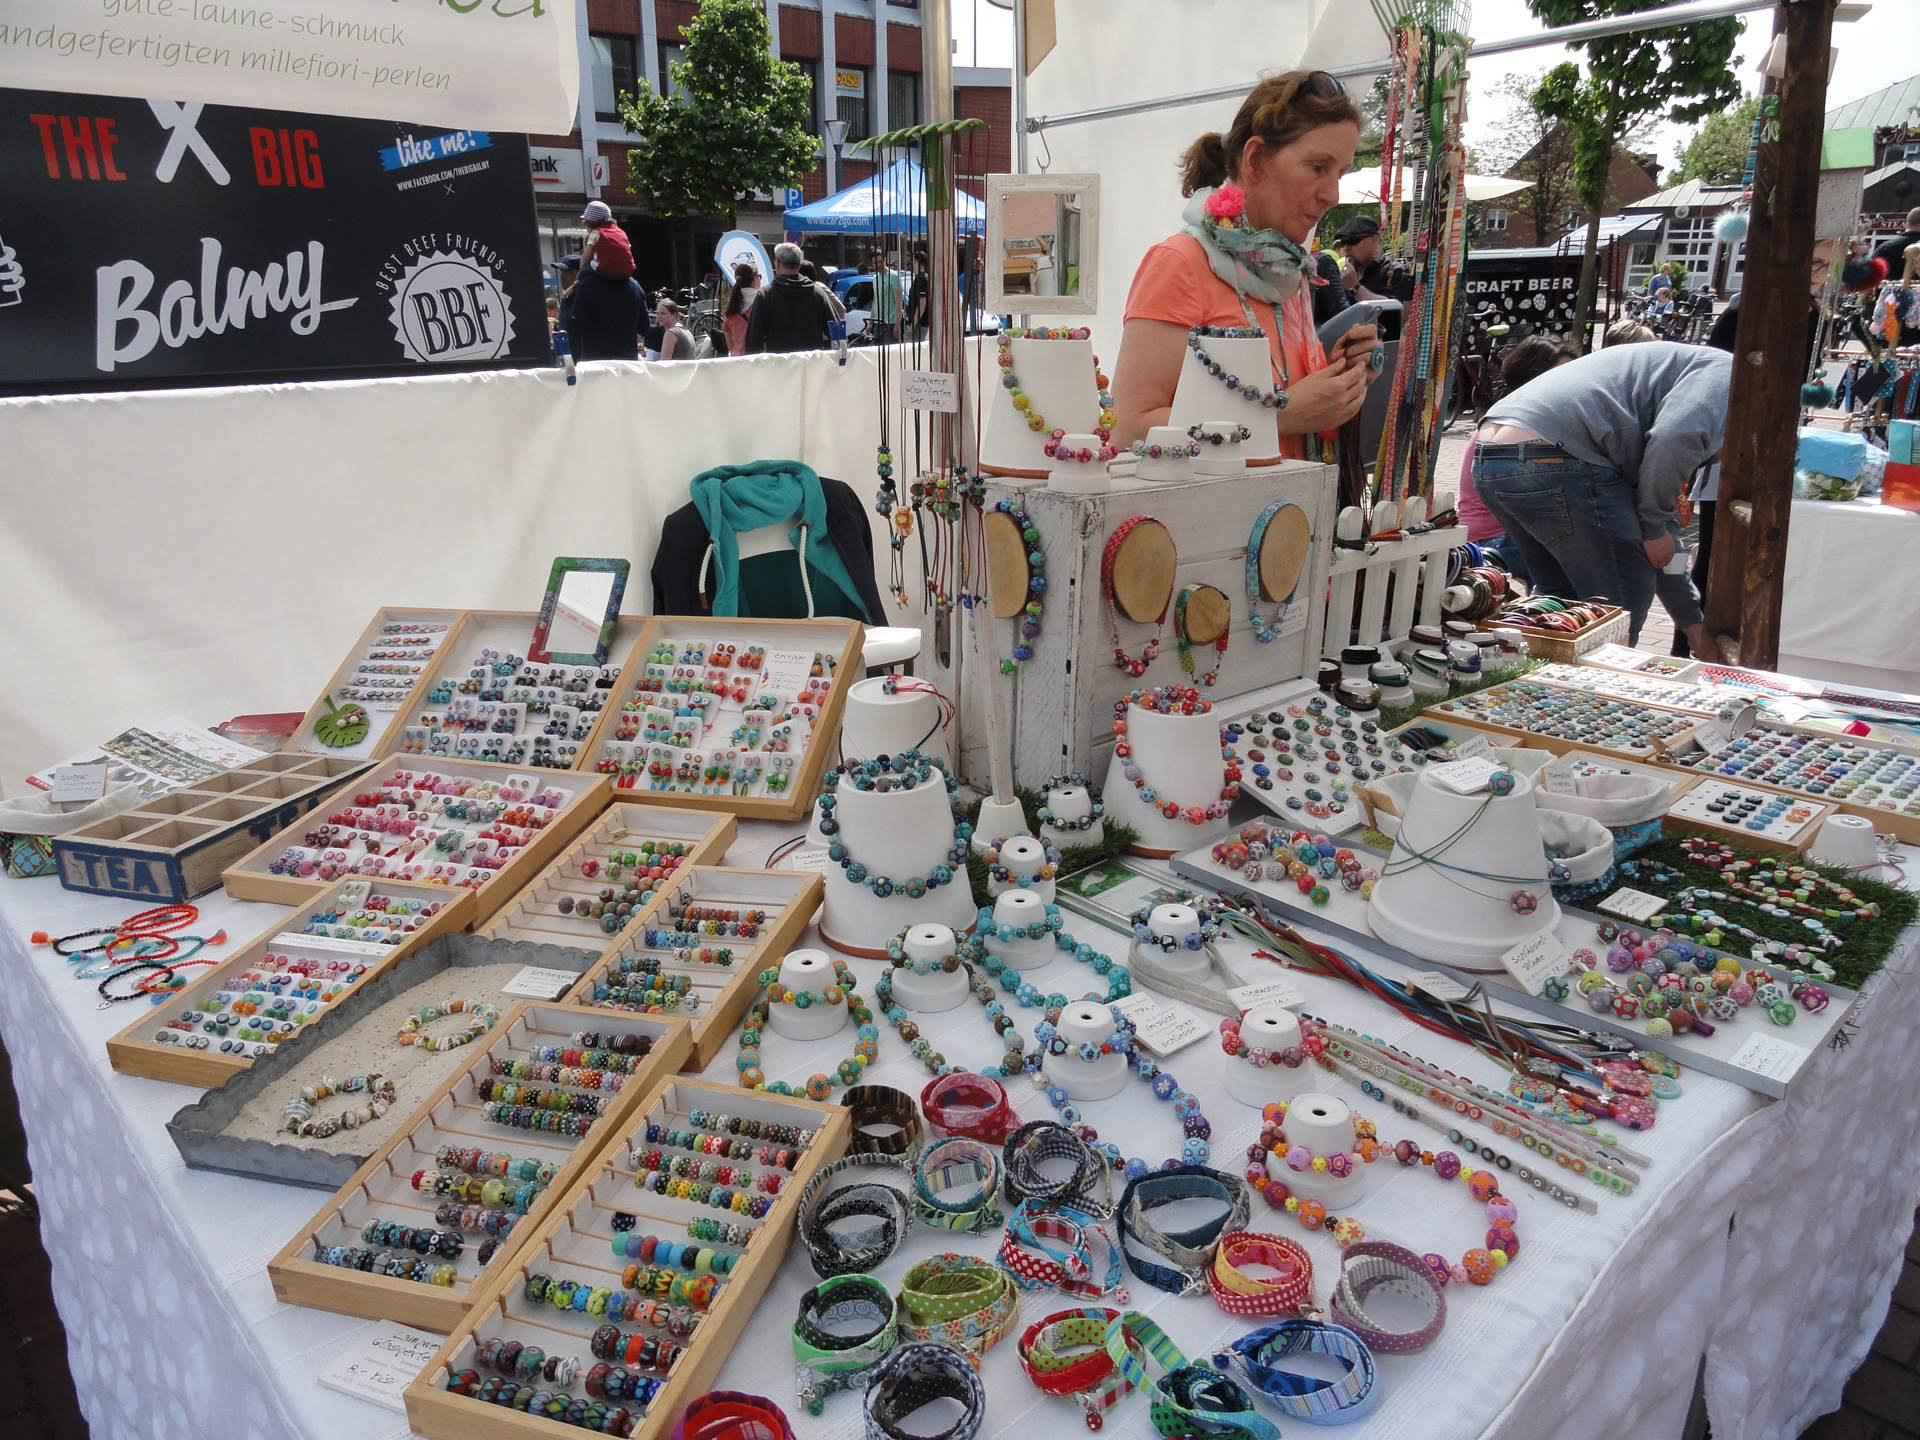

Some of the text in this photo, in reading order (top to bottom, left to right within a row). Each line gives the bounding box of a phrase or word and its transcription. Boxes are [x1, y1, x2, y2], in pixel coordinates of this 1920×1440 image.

[0, 24, 451, 90] andgefertigten millefiori-perlen
[840, 72, 862, 88] ASB
[30, 113, 325, 189] THE BIG
[396, 129, 477, 168] like me!
[396, 160, 490, 192] WWW.FACEBOOK.COM/THEBIGBALMY
[531, 155, 558, 173] ank
[788, 187, 799, 207] P
[806, 216, 870, 228] www.car2go.com
[1880, 220, 1907, 228] STEA
[376, 233, 506, 291] BEST BEEF FRIENDS
[1465, 277, 1574, 294] CRAFT BEER
[97, 237, 359, 372] Balmy
[409, 281, 494, 356] BBF
[73, 852, 161, 895] TEA
[372, 1337, 432, 1362] Glasperle
[393, 1331, 442, 1351] Lampwer
